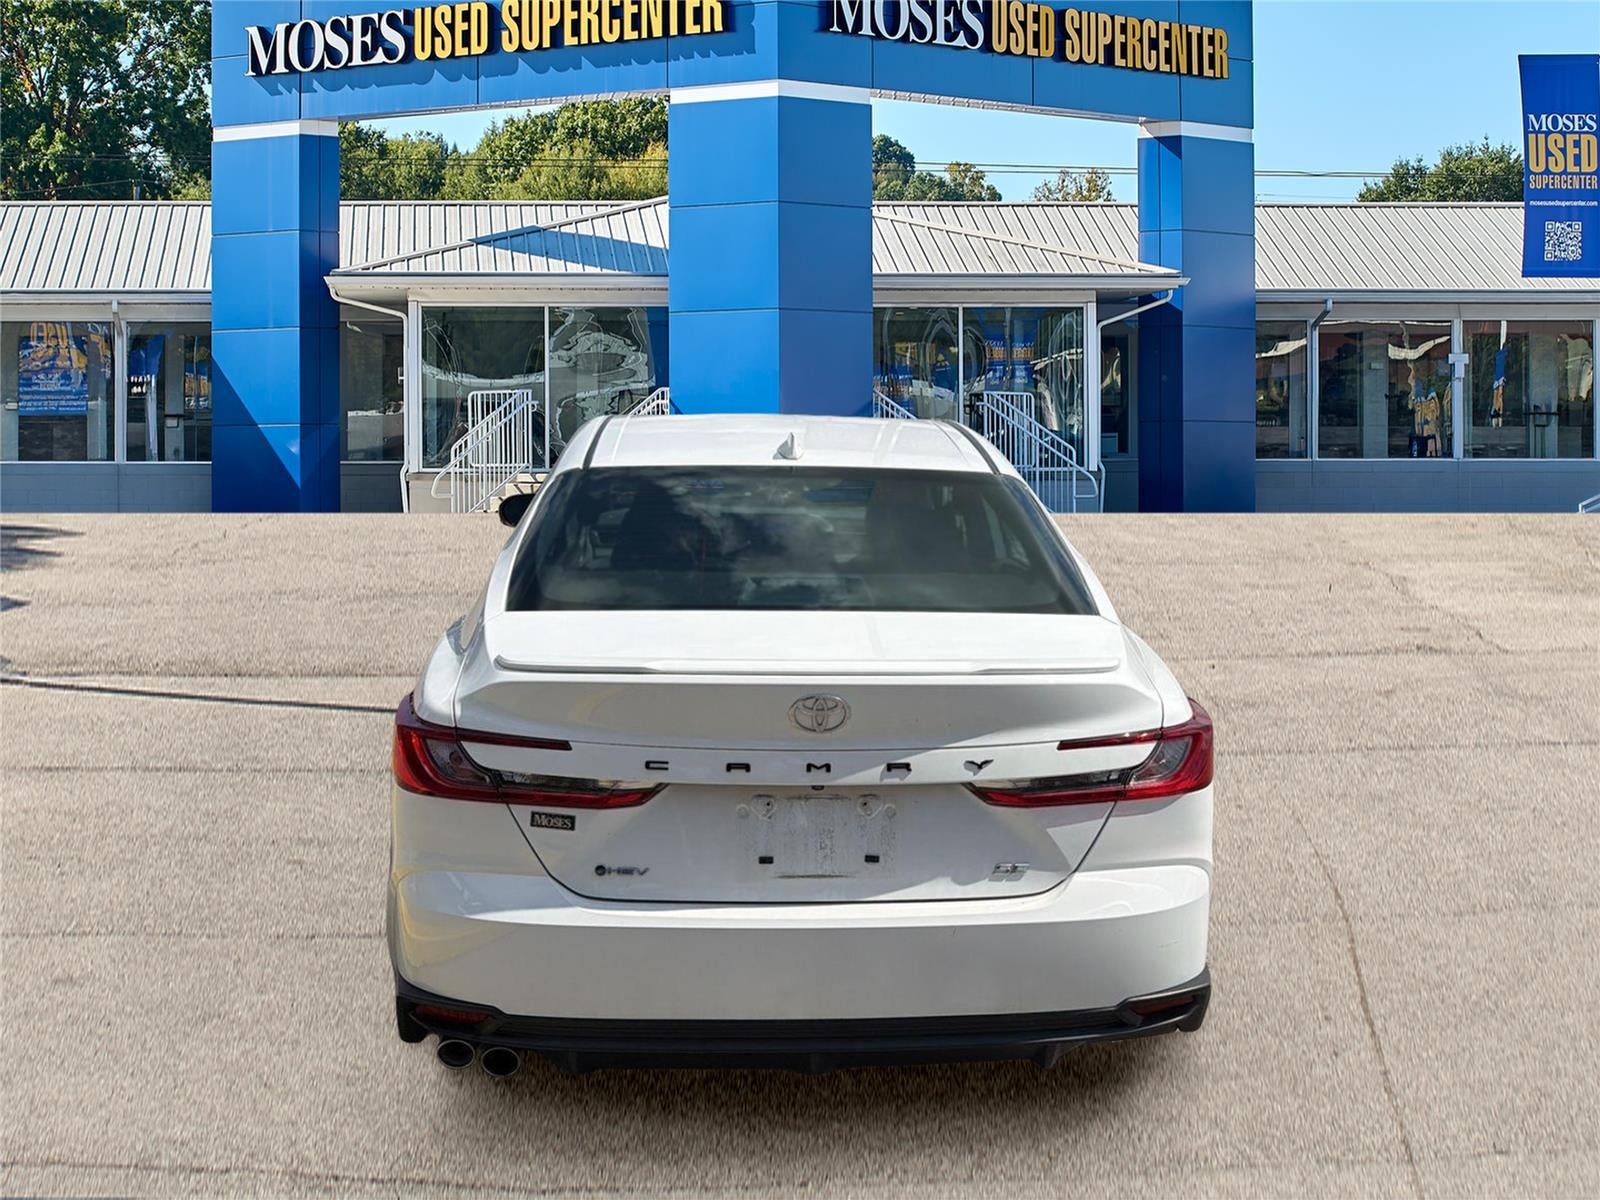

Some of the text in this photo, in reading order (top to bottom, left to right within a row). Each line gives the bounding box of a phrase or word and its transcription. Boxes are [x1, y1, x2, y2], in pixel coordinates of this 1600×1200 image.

[244, 10, 406, 77] MOSES
[413, 2, 489, 61] USED
[829, 0, 1229, 79] MOSES USED SUPERCENTER
[1527, 114, 1598, 132] MOSES
[1528, 133, 1598, 173] USED
[1529, 174, 1598, 190] SUPERCENTER
[645, 758, 994, 773] CAMRY
[607, 867, 650, 876] HEV
